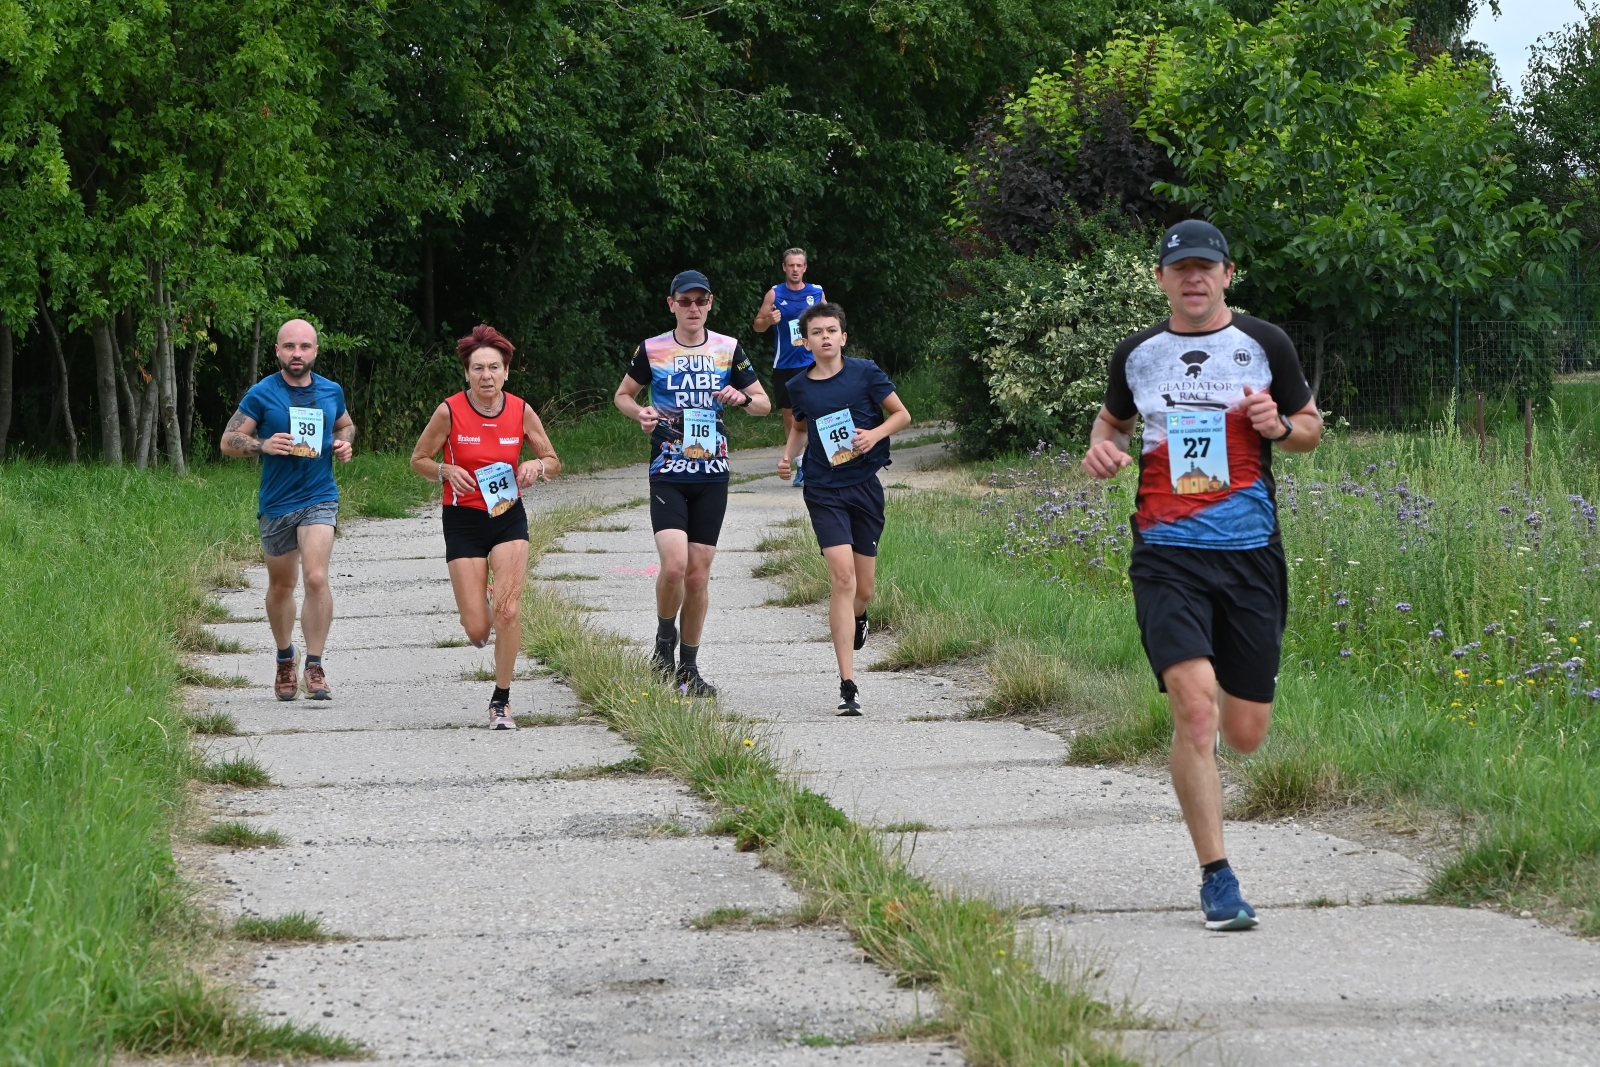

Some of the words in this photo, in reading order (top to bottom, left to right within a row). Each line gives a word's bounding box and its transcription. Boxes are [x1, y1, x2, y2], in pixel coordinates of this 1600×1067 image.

[673, 355, 715, 373] RUN
[666, 373, 722, 391] LABE
[1158, 381, 1234, 392] GLADIATOR
[675, 391, 714, 408] RUN
[1179, 392, 1211, 401] RACE
[298, 421, 316, 436] 39
[690, 423, 710, 438] 116
[829, 426, 849, 443] 46
[1183, 437, 1211, 459] 27
[660, 459, 700, 473] 380
[705, 460, 729, 474] KM
[488, 476, 509, 494] 84
